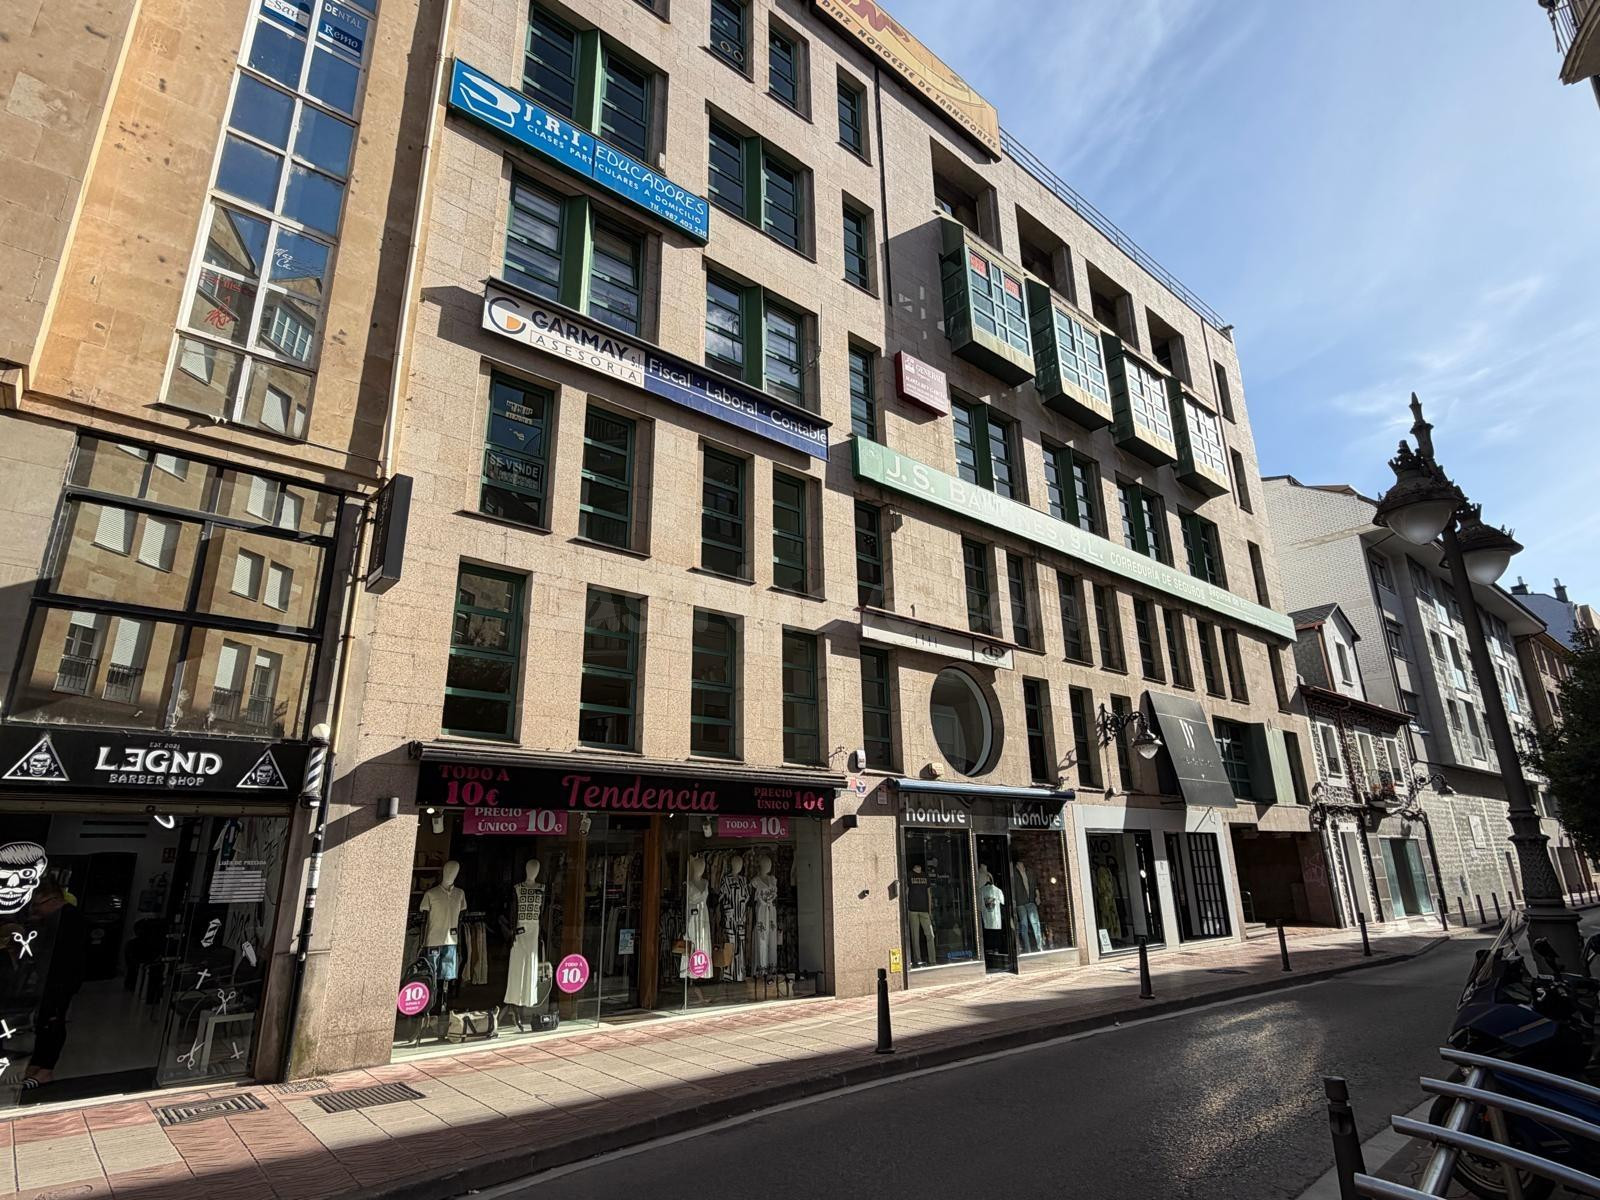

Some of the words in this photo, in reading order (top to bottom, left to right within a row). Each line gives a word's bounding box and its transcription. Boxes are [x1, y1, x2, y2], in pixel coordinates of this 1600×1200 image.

[273, 0, 300, 20] San
[324, 23, 359, 48] Remo
[325, 3, 362, 29] DENTAL
[857, 29, 915, 79] NOROESTE
[917, 80, 932, 93] DE
[935, 94, 997, 149] TRANSPORTES
[524, 104, 588, 152] J.R.I.
[595, 146, 705, 216] EDUCADORES
[527, 124, 564, 149] CLASES
[569, 147, 639, 190] PARTICULARES
[643, 189, 650, 197] A
[655, 195, 702, 224] DOMICILIO
[531, 311, 629, 361] GARMAY
[536, 335, 637, 382] ASESORIA
[649, 359, 691, 388] Fiscal
[705, 380, 758, 416] Laboral
[770, 410, 827, 444] Contable
[506, 460, 539, 479] VENDE
[887, 456, 936, 493] J.S.
[1162, 574, 1172, 587] DE
[109, 774, 164, 786] BARBER
[168, 775, 205, 787] SHOP
[440, 765, 493, 780] TODO
[497, 768, 510, 781] A
[446, 780, 499, 806] 10€
[562, 775, 719, 811] Tendencia
[754, 787, 792, 798] PRECIO
[794, 791, 825, 811] 10€
[474, 807, 522, 817] PRECIO
[725, 820, 748, 829] TODO
[749, 821, 757, 829] A
